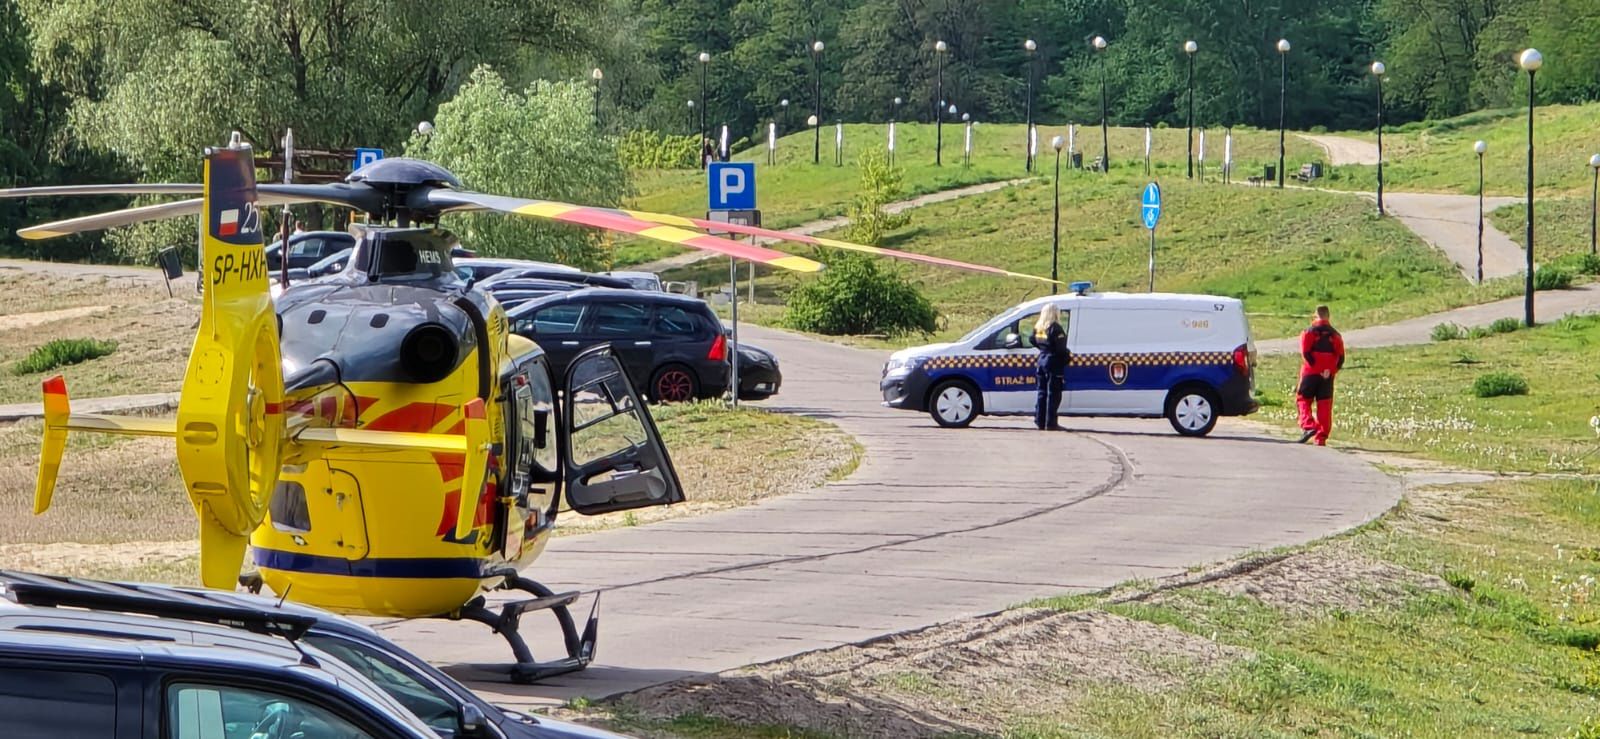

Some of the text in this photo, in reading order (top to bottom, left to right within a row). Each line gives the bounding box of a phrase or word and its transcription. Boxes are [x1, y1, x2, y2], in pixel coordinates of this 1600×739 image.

[720, 167, 746, 204] P
[241, 201, 259, 234] 25
[418, 249, 441, 265] HEMS
